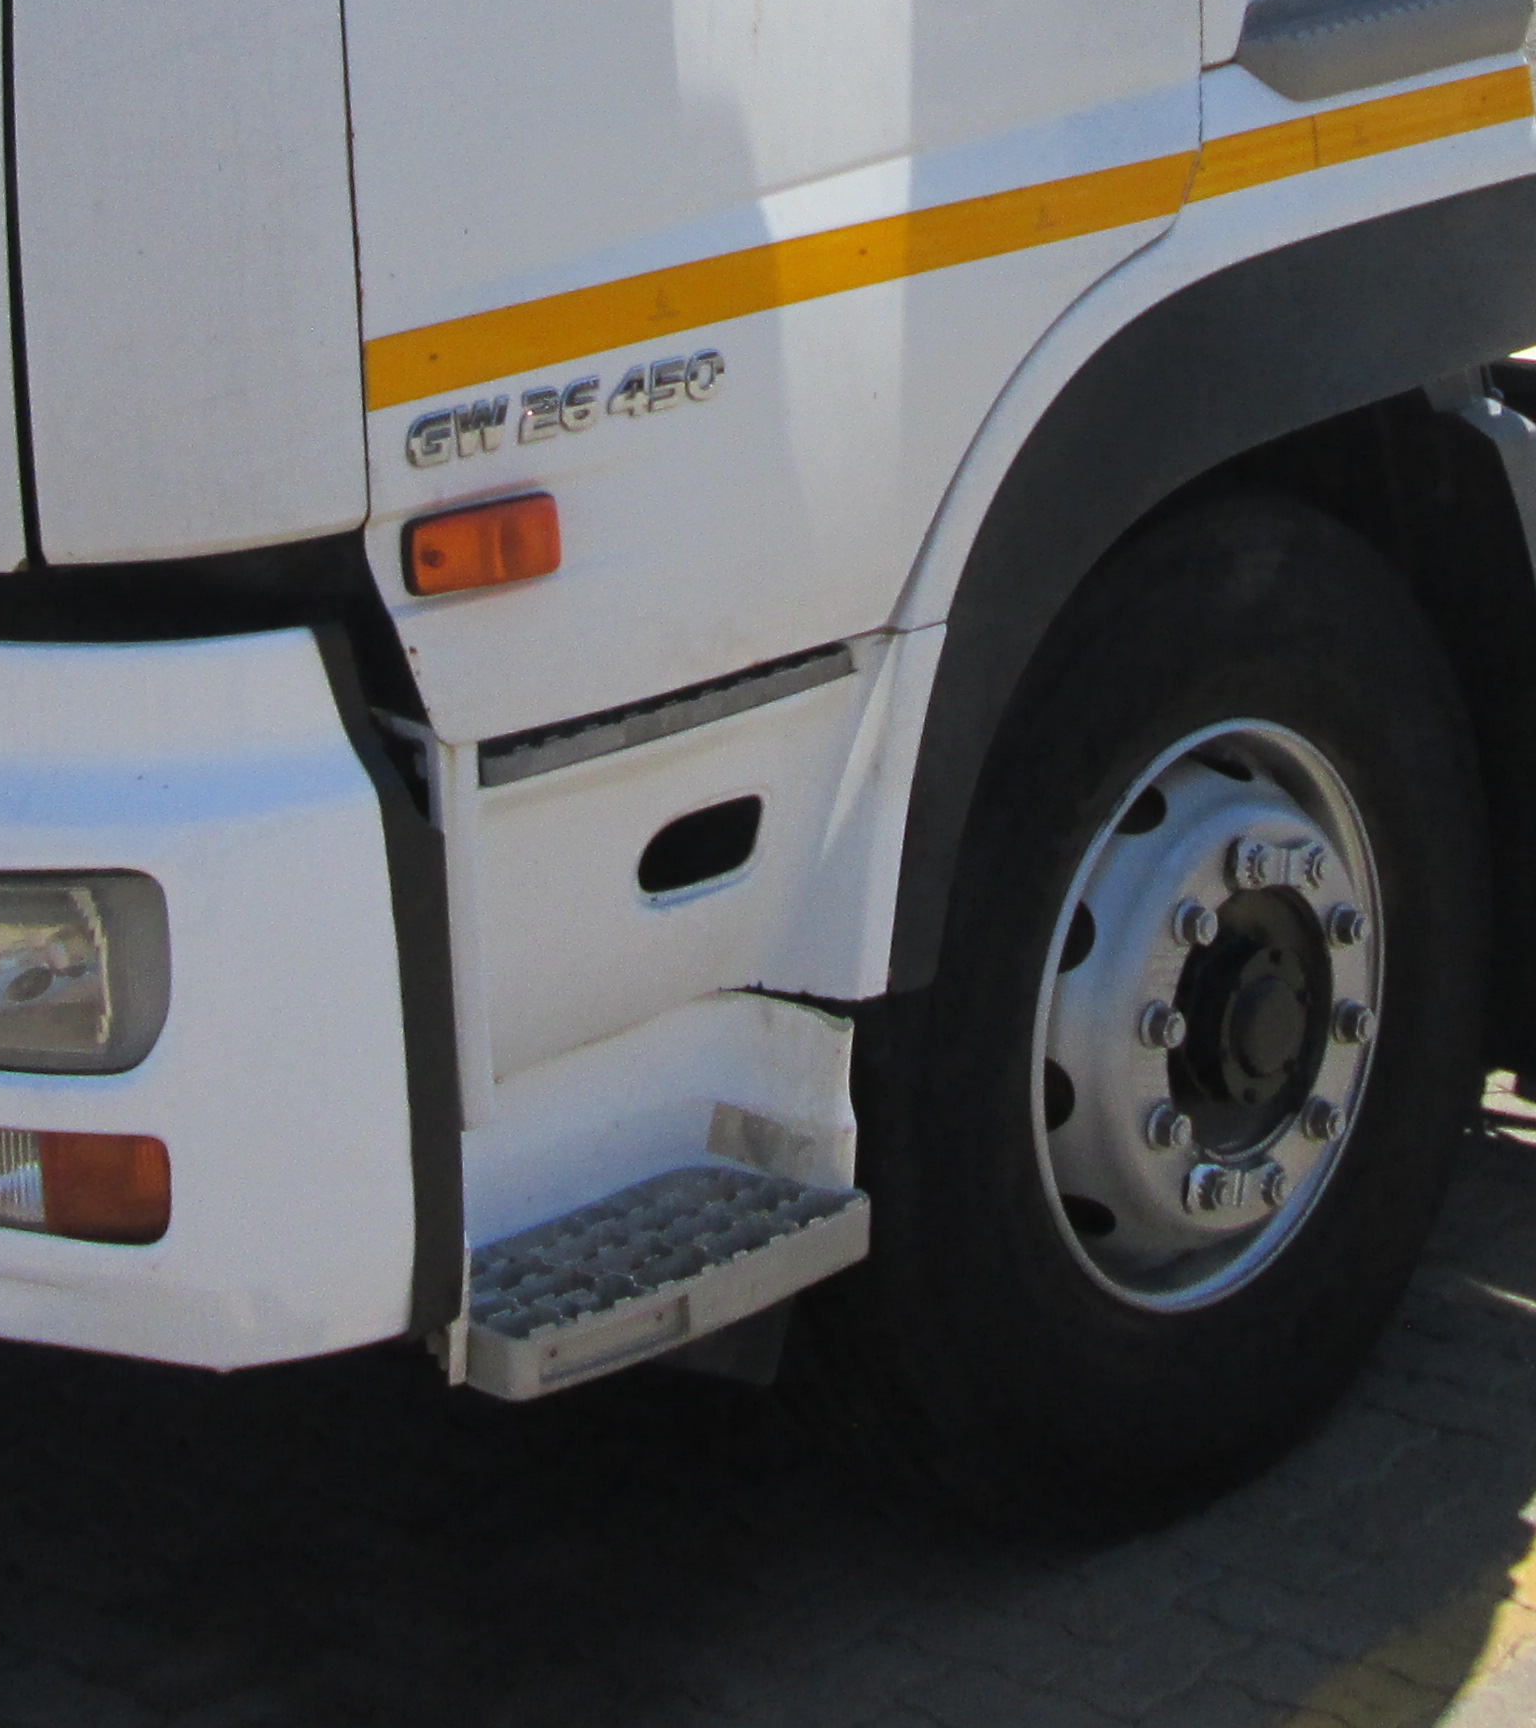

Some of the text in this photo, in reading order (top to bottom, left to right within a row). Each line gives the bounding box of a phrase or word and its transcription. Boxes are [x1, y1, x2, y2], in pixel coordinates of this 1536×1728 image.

[405, 347, 727, 469] GW 26 450
